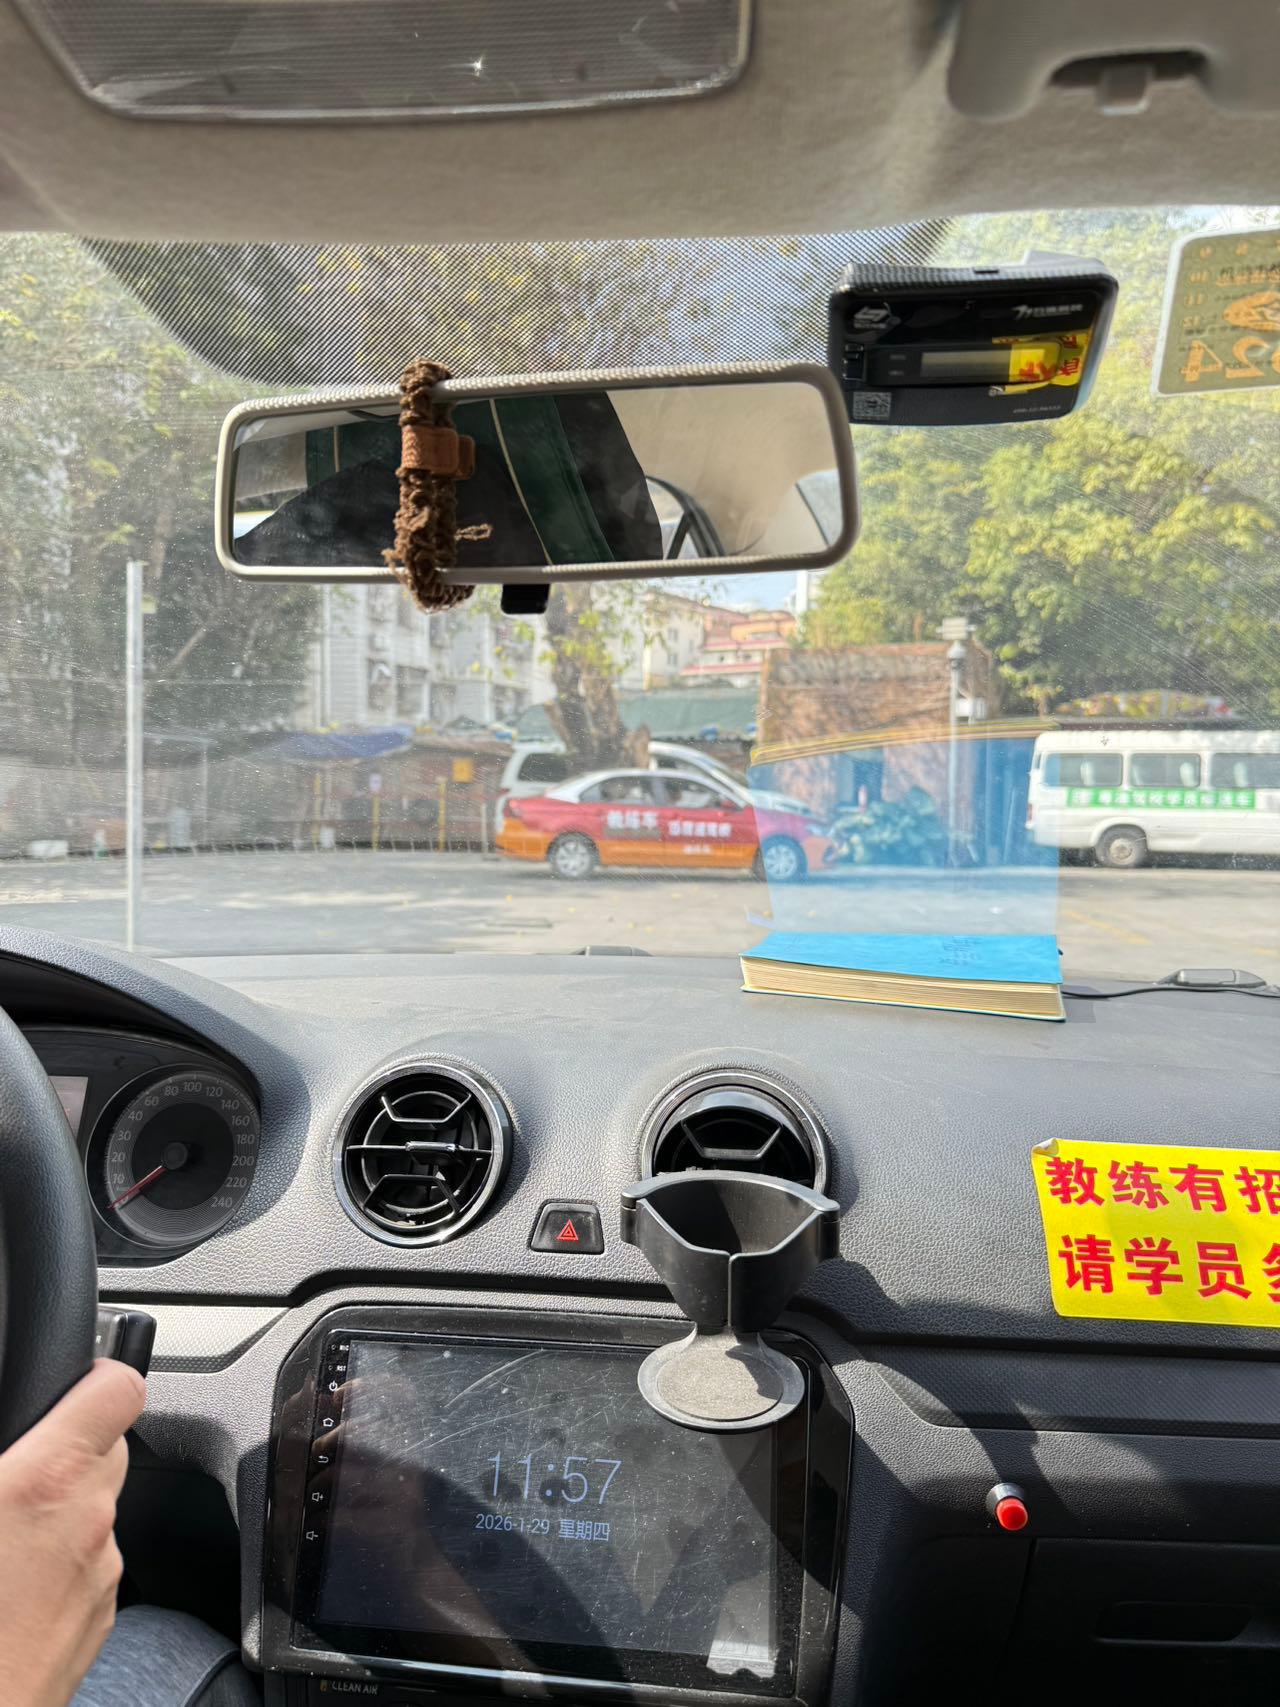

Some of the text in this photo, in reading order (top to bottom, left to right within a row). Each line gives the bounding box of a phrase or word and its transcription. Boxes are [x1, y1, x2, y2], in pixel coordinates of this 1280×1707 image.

[164, 1085, 179, 1096] 80
[183, 1081, 202, 1092] 100
[205, 1086, 223, 1097] 120
[144, 1096, 159, 1106] 60
[221, 1099, 239, 1110] 140
[128, 1110, 143, 1121] 40
[231, 1114, 250, 1126] 160
[119, 1130, 131, 1141] 30
[237, 1133, 255, 1145] 180
[111, 1151, 125, 1162] 20
[232, 1155, 254, 1166] 200
[113, 1173, 125, 1184] 10
[225, 1177, 247, 1188] 220
[1045, 1157, 1280, 1215] 教练有招
[210, 1197, 232, 1208] 240
[488, 1451, 622, 1505] 11:57
[475, 1513, 611, 1542] 2026-1-29 星期四
[332, 1681, 361, 1693] CLEAN
